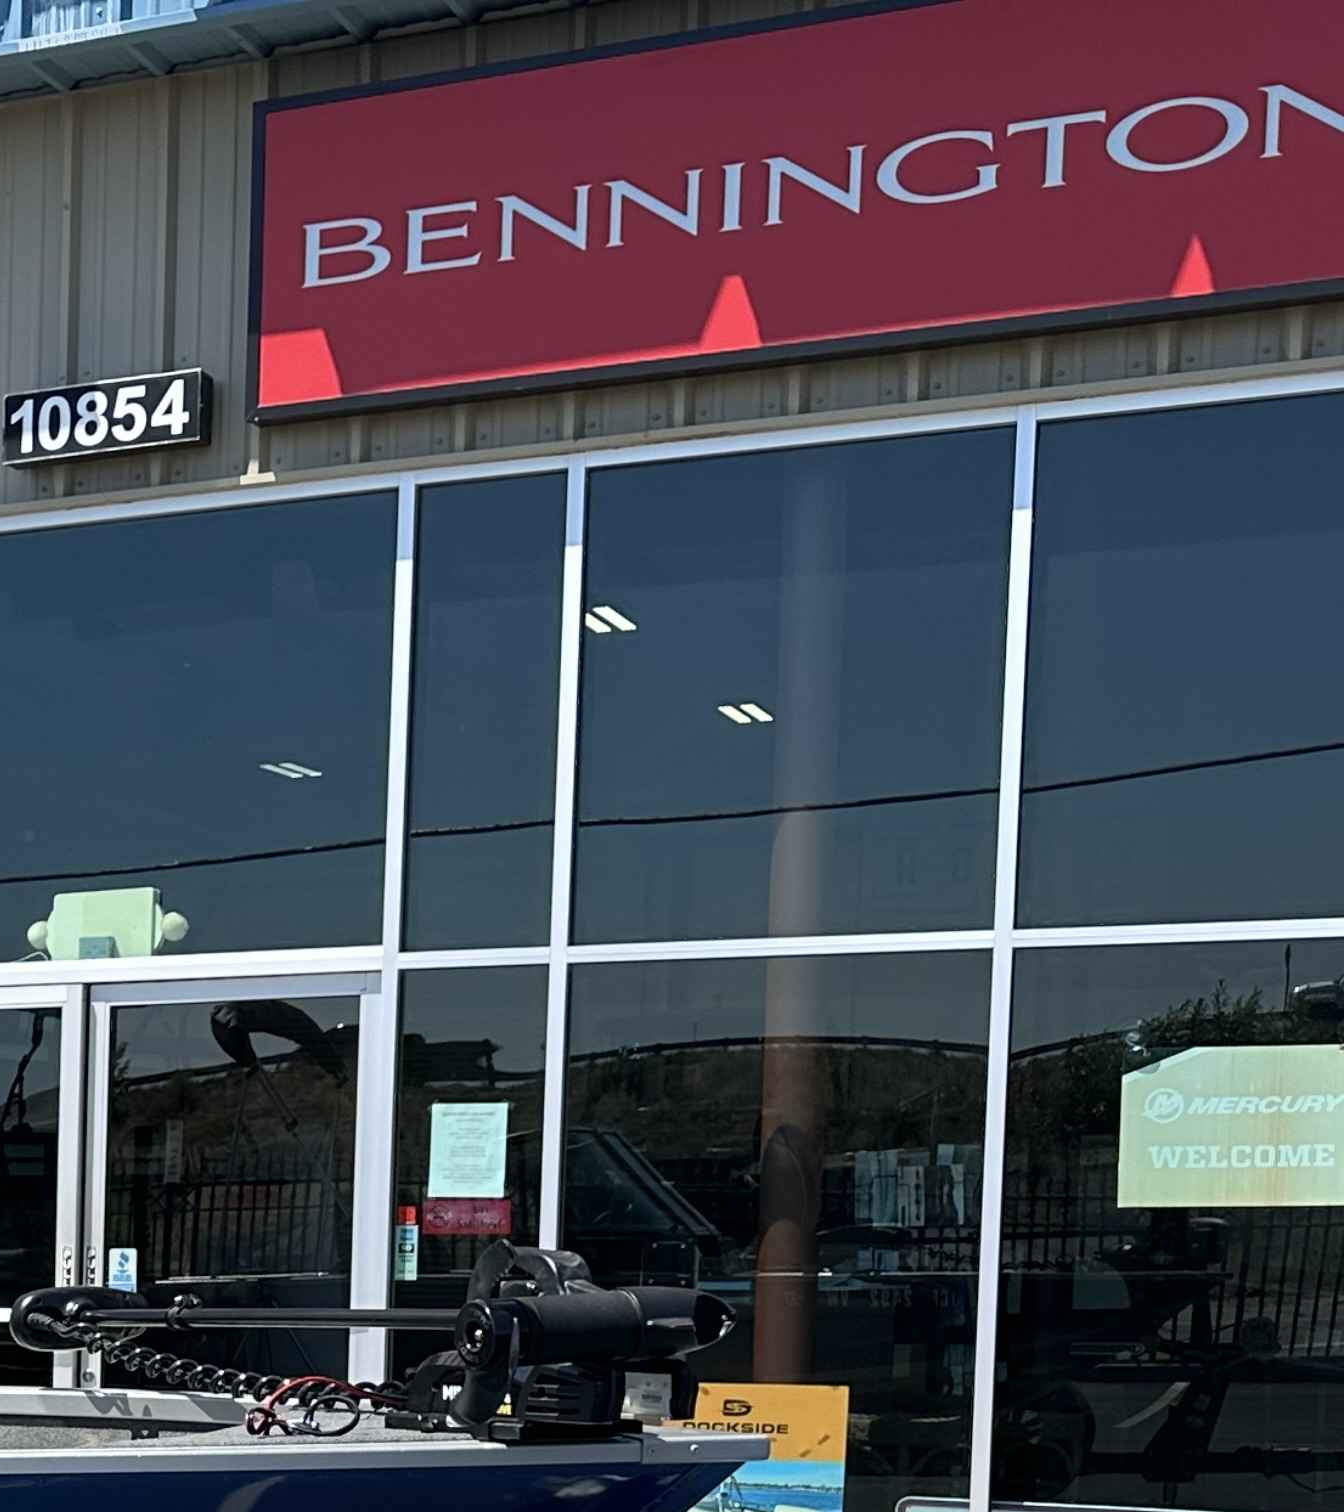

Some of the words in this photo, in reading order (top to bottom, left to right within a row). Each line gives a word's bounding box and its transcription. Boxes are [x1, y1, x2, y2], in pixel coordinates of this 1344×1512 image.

[299, 84, 1344, 289] BENNINGTON
[10, 378, 190, 454] 10854
[1187, 1094, 1344, 1115] MERCURY
[1148, 1143, 1336, 1169] WELCOME
